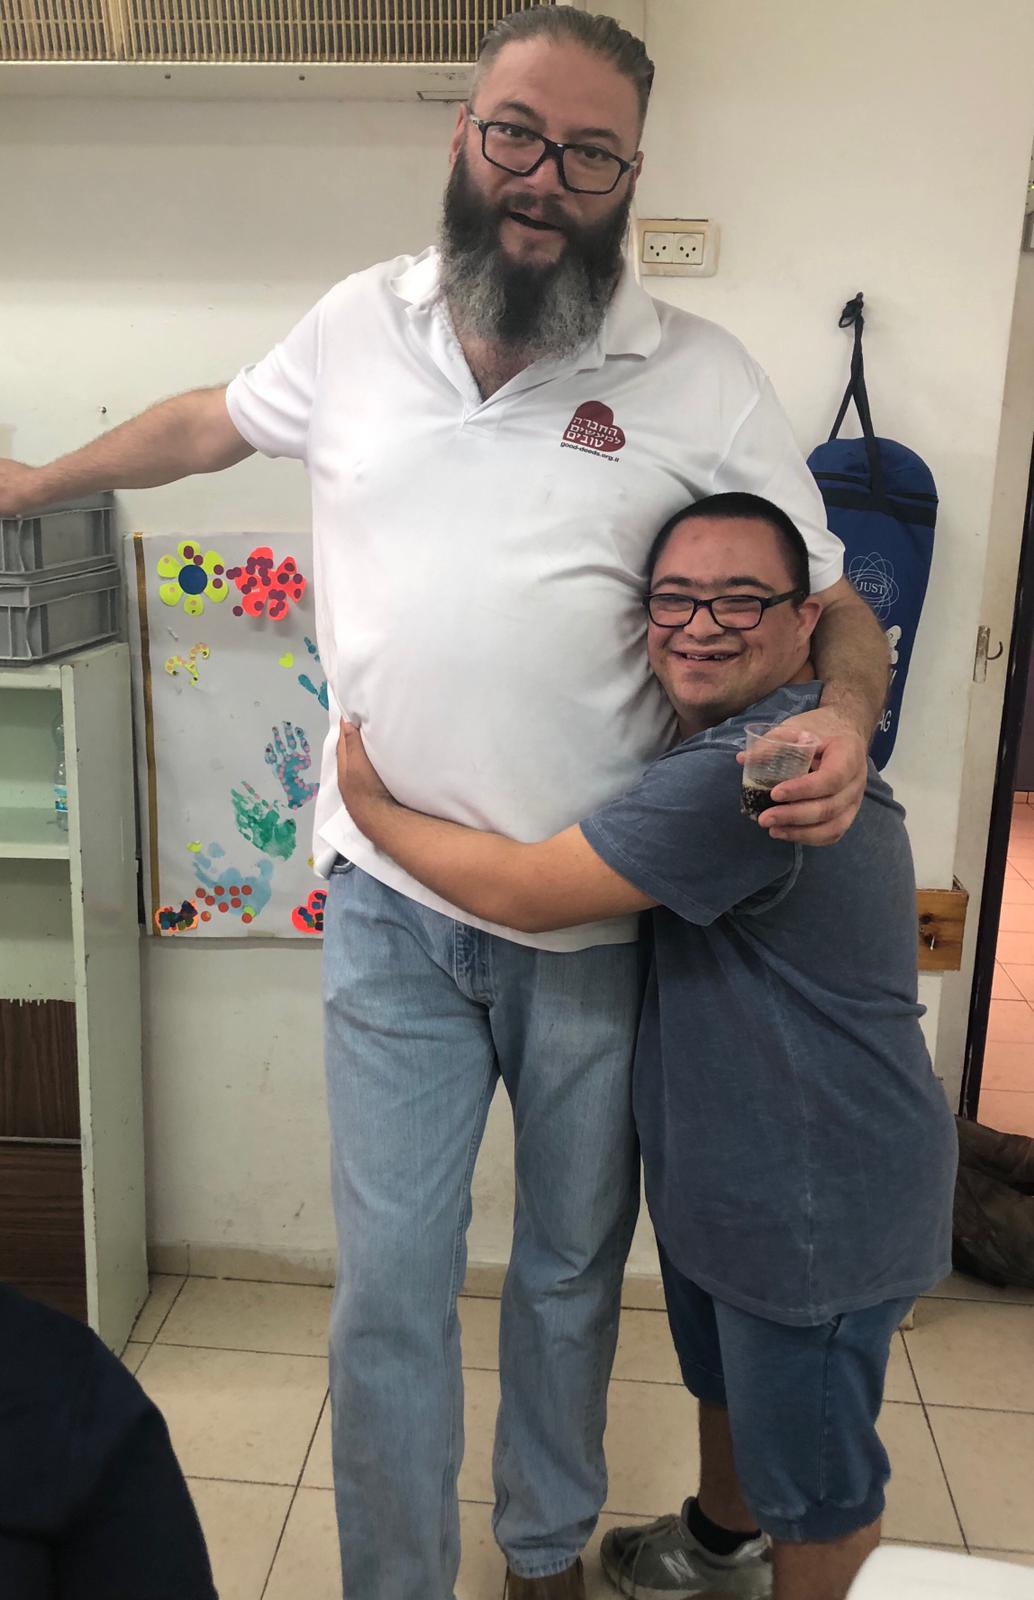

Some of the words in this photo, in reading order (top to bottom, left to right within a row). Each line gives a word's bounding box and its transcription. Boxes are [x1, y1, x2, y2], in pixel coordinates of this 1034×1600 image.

[566, 431, 604, 447] טובים
[570, 424, 621, 444] למעשים
[855, 581, 886, 595] JUST
[877, 710, 892, 732] AG
